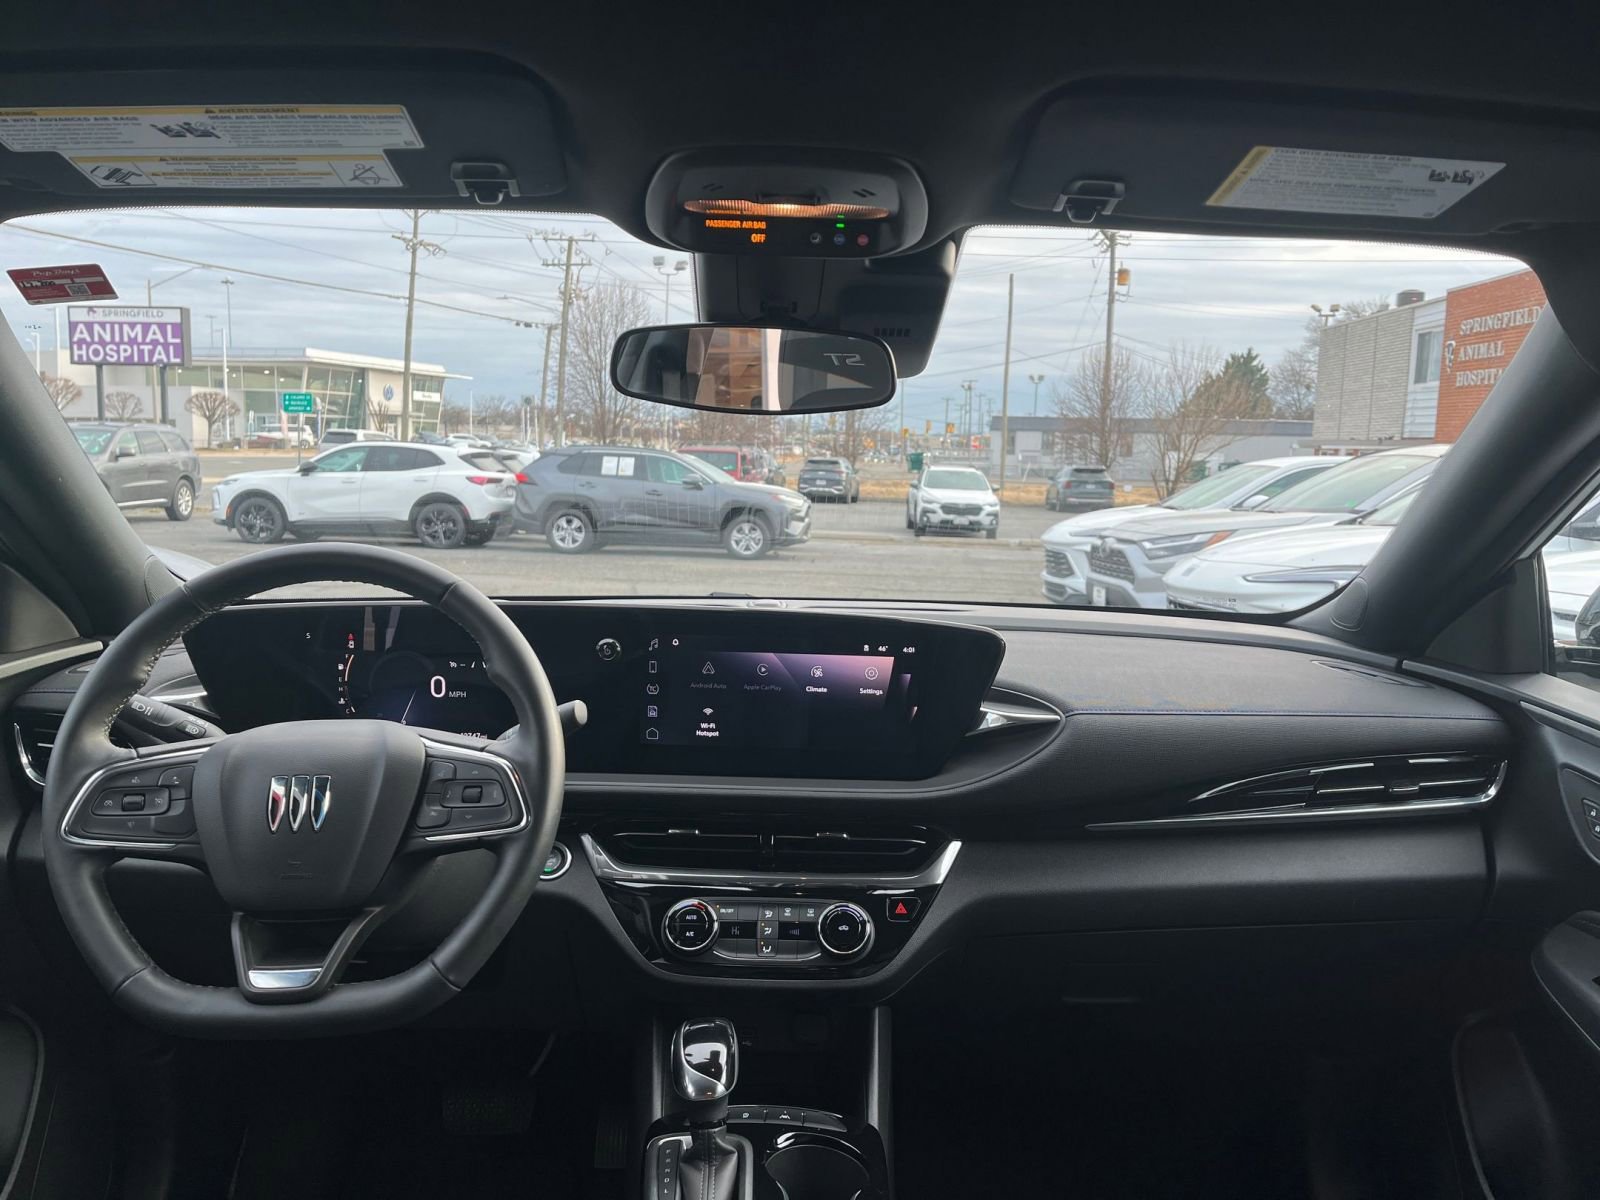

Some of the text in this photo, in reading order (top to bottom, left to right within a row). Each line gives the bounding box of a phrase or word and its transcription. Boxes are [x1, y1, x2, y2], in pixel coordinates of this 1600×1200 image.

[705, 219, 766, 229] PASSENGER AIR BAG
[751, 233, 766, 243] OFF
[102, 309, 164, 318] SPRINGFIELD
[1460, 306, 1541, 336] SPRINGFIELD
[72, 323, 182, 343] ANIMAL
[73, 343, 182, 363] HOSPITAL
[1458, 340, 1505, 361] ANIMAL
[1456, 368, 1503, 387] HOSPIT
[430, 675, 446, 698] 0
[744, 683, 782, 692] Apple CarPlay
[859, 687, 883, 696] Settings
[731, 926, 740, 936] Hi
